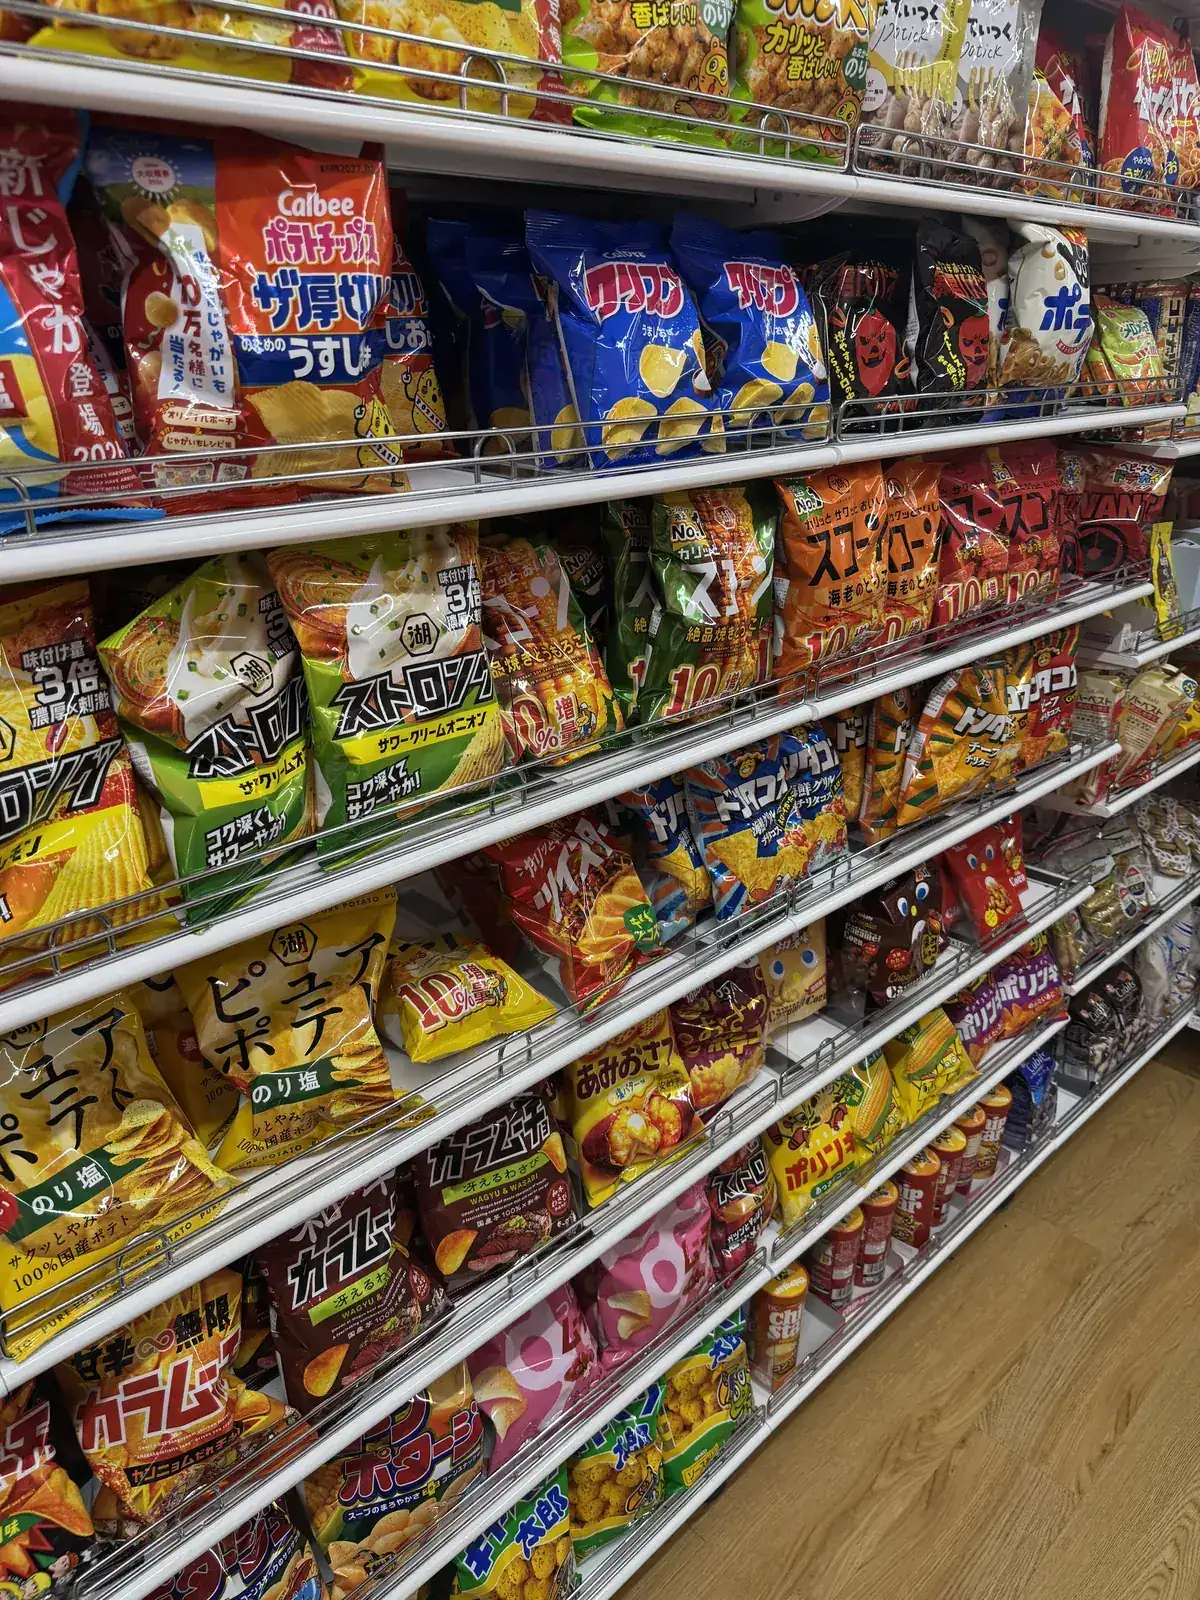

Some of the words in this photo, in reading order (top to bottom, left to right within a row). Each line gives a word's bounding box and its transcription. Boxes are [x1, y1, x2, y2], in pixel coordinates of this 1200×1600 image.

[764, 20, 826, 57] カリッと
[277, 190, 355, 217] Calbee
[263, 216, 380, 265] ポテトチップス
[796, 487, 824, 515] No.1
[804, 513, 832, 531] カリッと
[806, 513, 888, 586] スコーン
[438, 565, 475, 584] 味付け量
[446, 580, 480, 612] 3倍
[407, 624, 432, 648] 湖
[22, 640, 86, 668] 味付け量
[33, 660, 100, 705] 3倍
[555, 693, 577, 748] 増量
[1130, 695, 1163, 715] ハーベスト
[378, 711, 488, 753] サワークリームオニオン
[347, 757, 408, 801] コク深くて
[343, 895, 379, 909] POTATO
[278, 930, 307, 957] 湖
[207, 932, 386, 1023] ピュア
[398, 972, 476, 1034] 10%
[204, 1082, 236, 1105] 100%
[252, 1070, 320, 1104] のり塩
[32, 1163, 105, 1216] のり塩
[462, 1155, 541, 1194] 冴えるわさび
[470, 1190, 500, 1206] WAGYU
[502, 1186, 509, 1195] &
[509, 1172, 539, 1192] WASABI
[13, 1214, 130, 1292] 100%国産ポテト
[342, 1297, 374, 1319] WAGYU
[348, 1490, 421, 1522] スープのまろやかさ
[515, 1484, 568, 1560] 太郎
